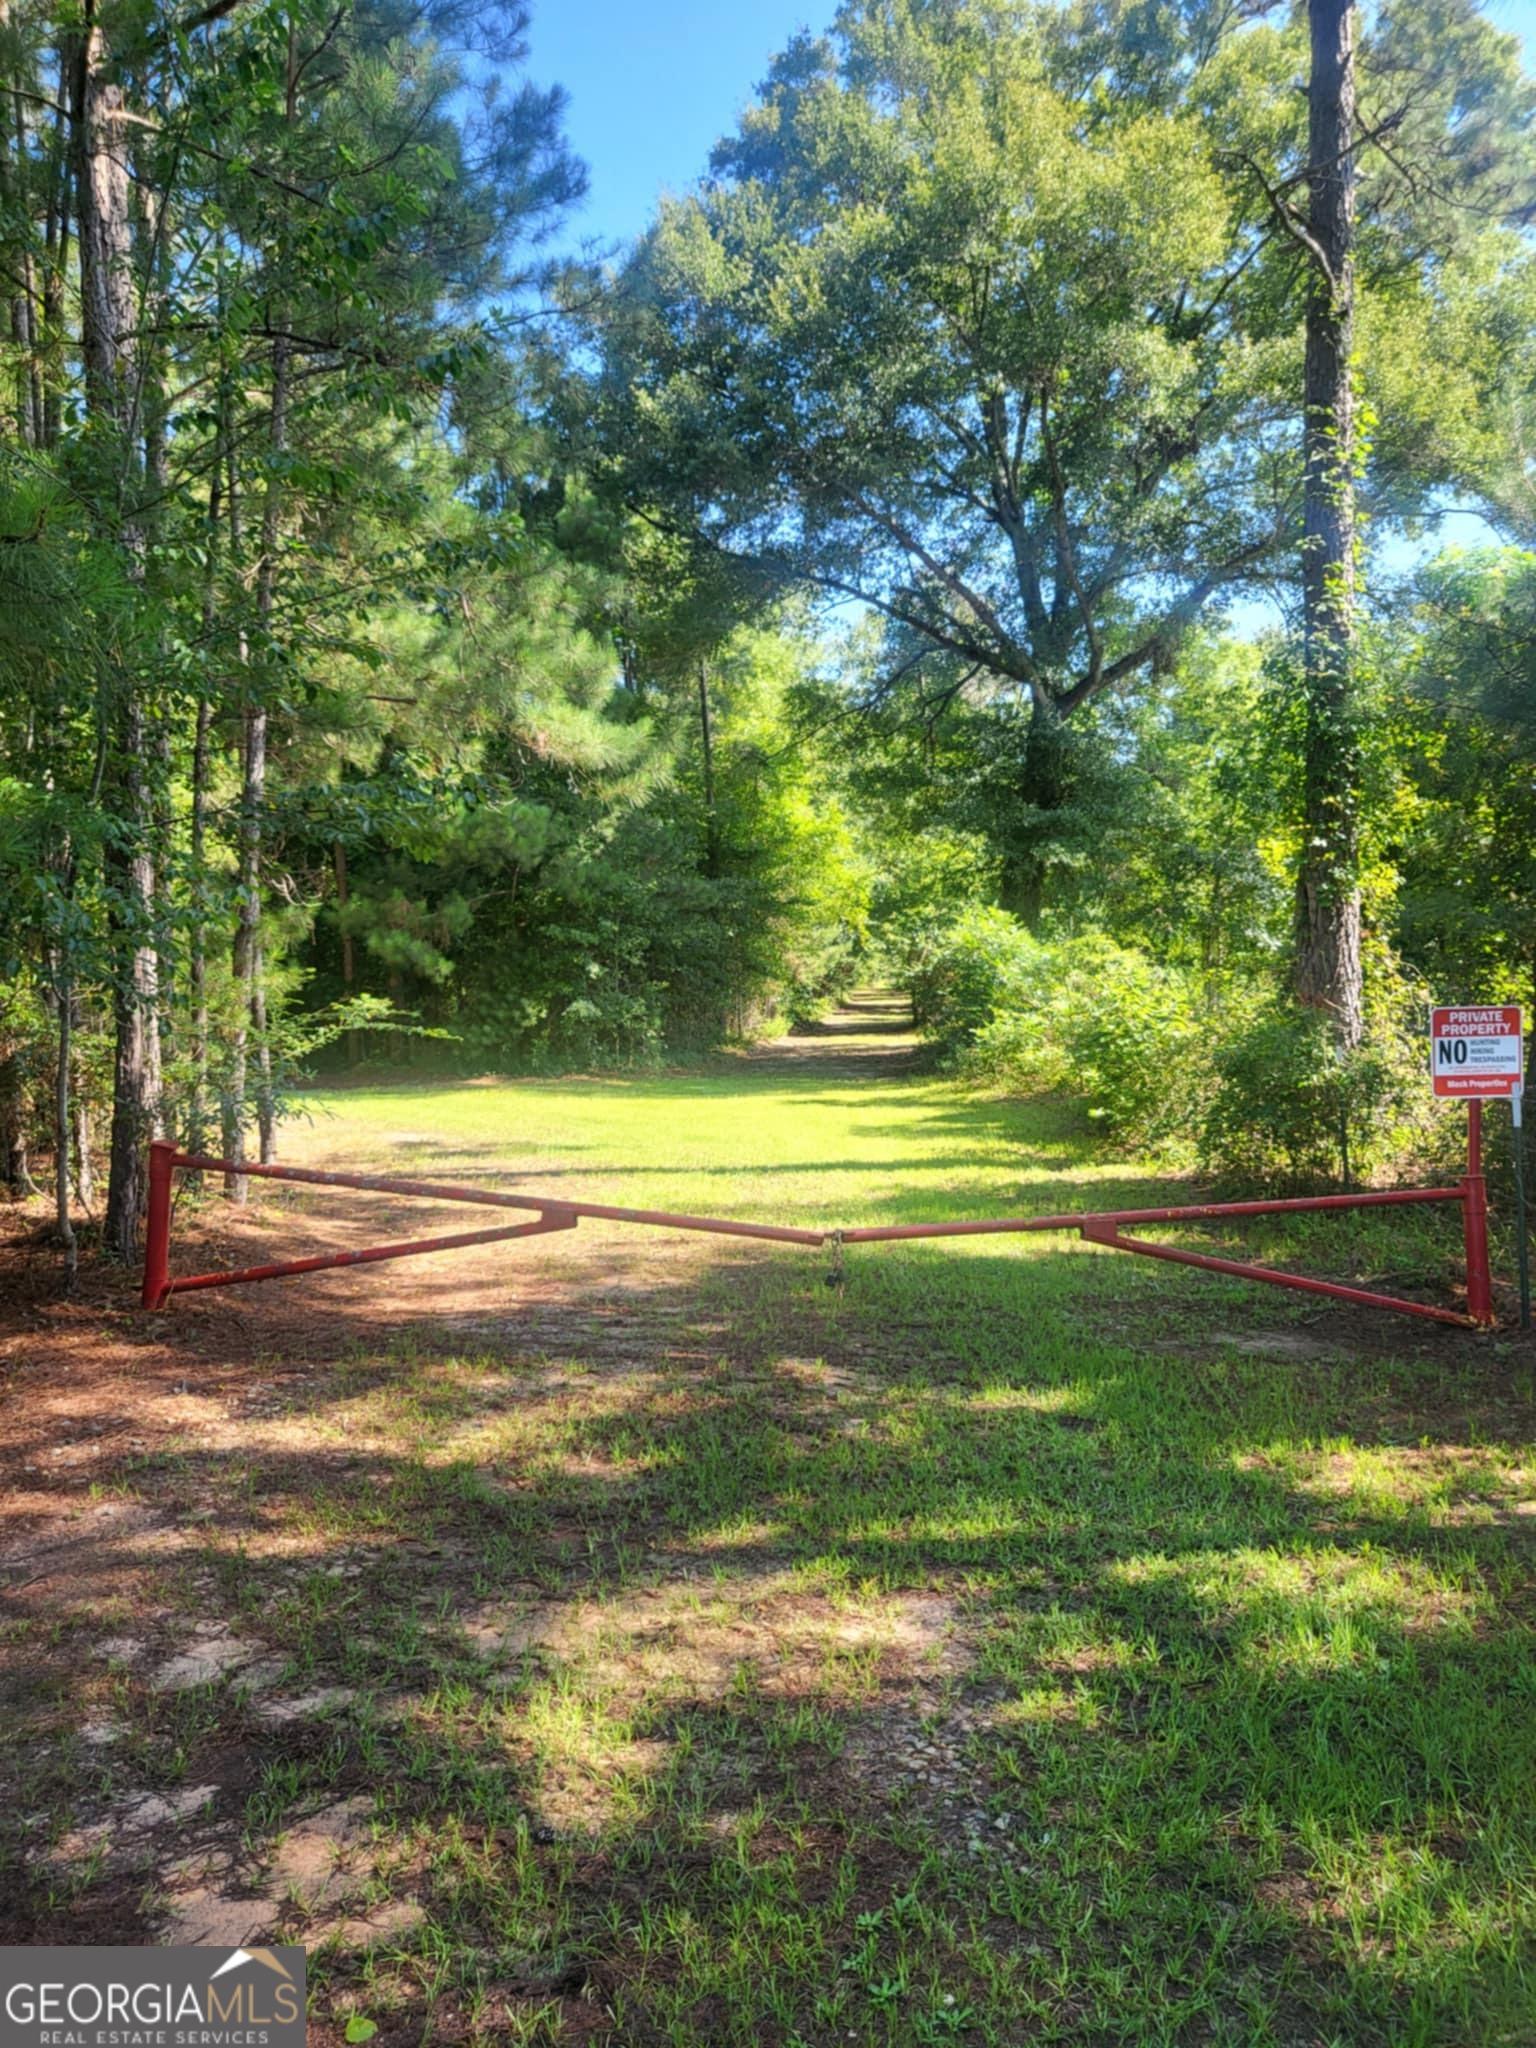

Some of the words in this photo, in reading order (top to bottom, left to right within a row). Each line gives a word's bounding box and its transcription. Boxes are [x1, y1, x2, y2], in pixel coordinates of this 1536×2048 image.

[1449, 1010, 1503, 1023] PRIVATE
[1441, 1023, 1511, 1035] PROPERTY
[1439, 1039, 1467, 1064] NO
